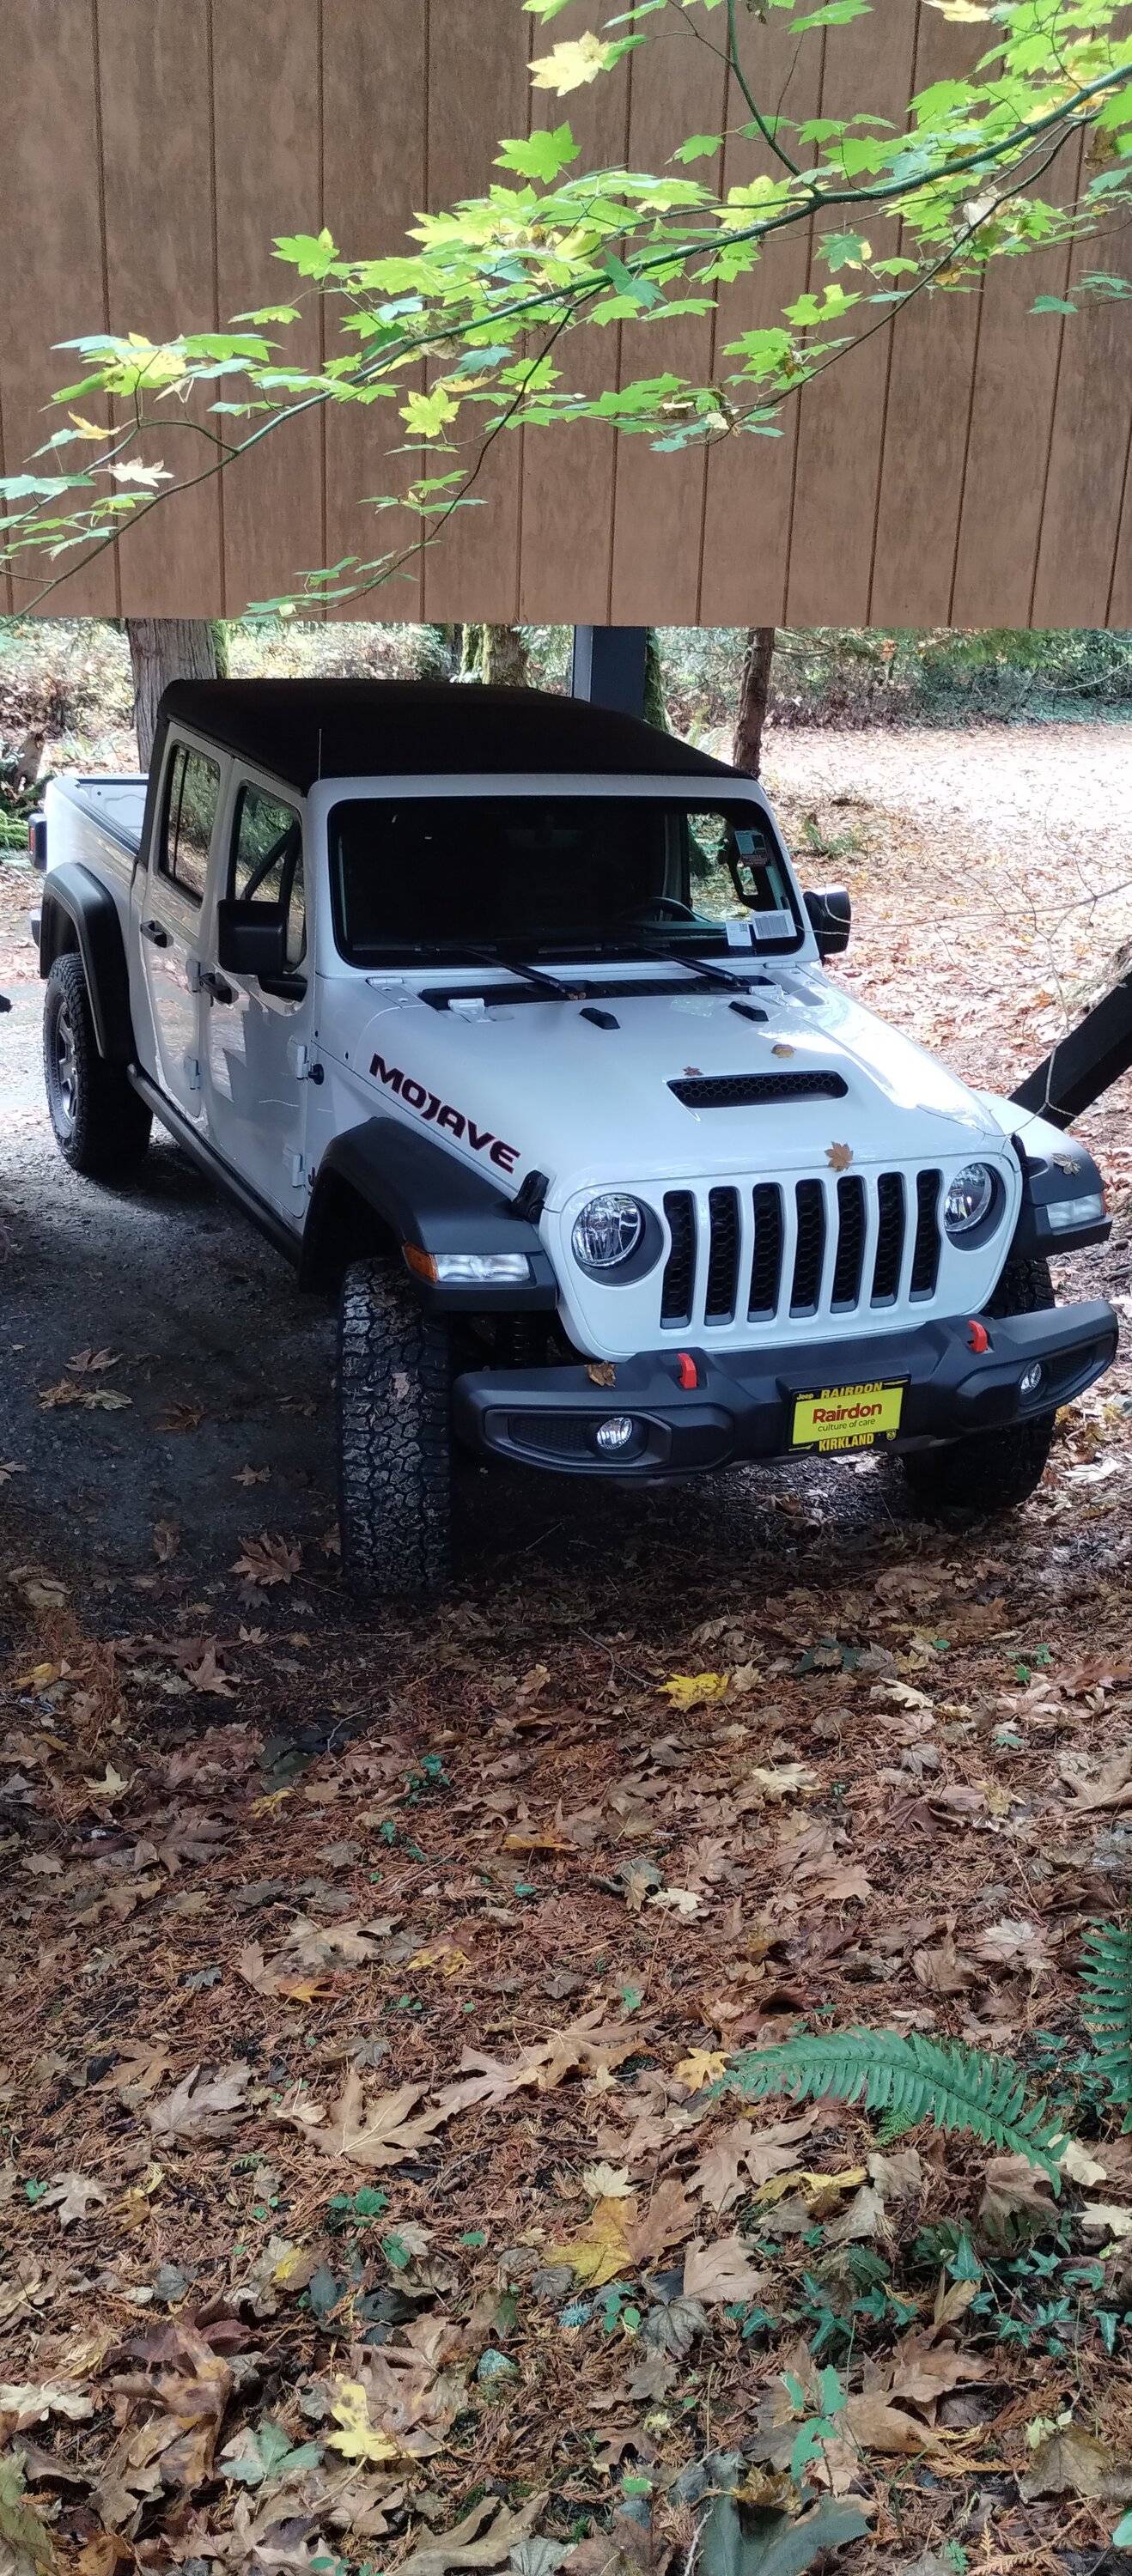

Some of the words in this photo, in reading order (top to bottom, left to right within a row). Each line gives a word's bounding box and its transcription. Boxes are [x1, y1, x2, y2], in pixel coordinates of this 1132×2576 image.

[369, 1053, 520, 1174] MOJAVE
[820, 1382, 883, 1400] RAIRDON
[812, 1403, 882, 1424] Rairdon
[818, 1422, 848, 1432] culture
[858, 1418, 876, 1427] care
[819, 1433, 874, 1452] KIRKLAND
